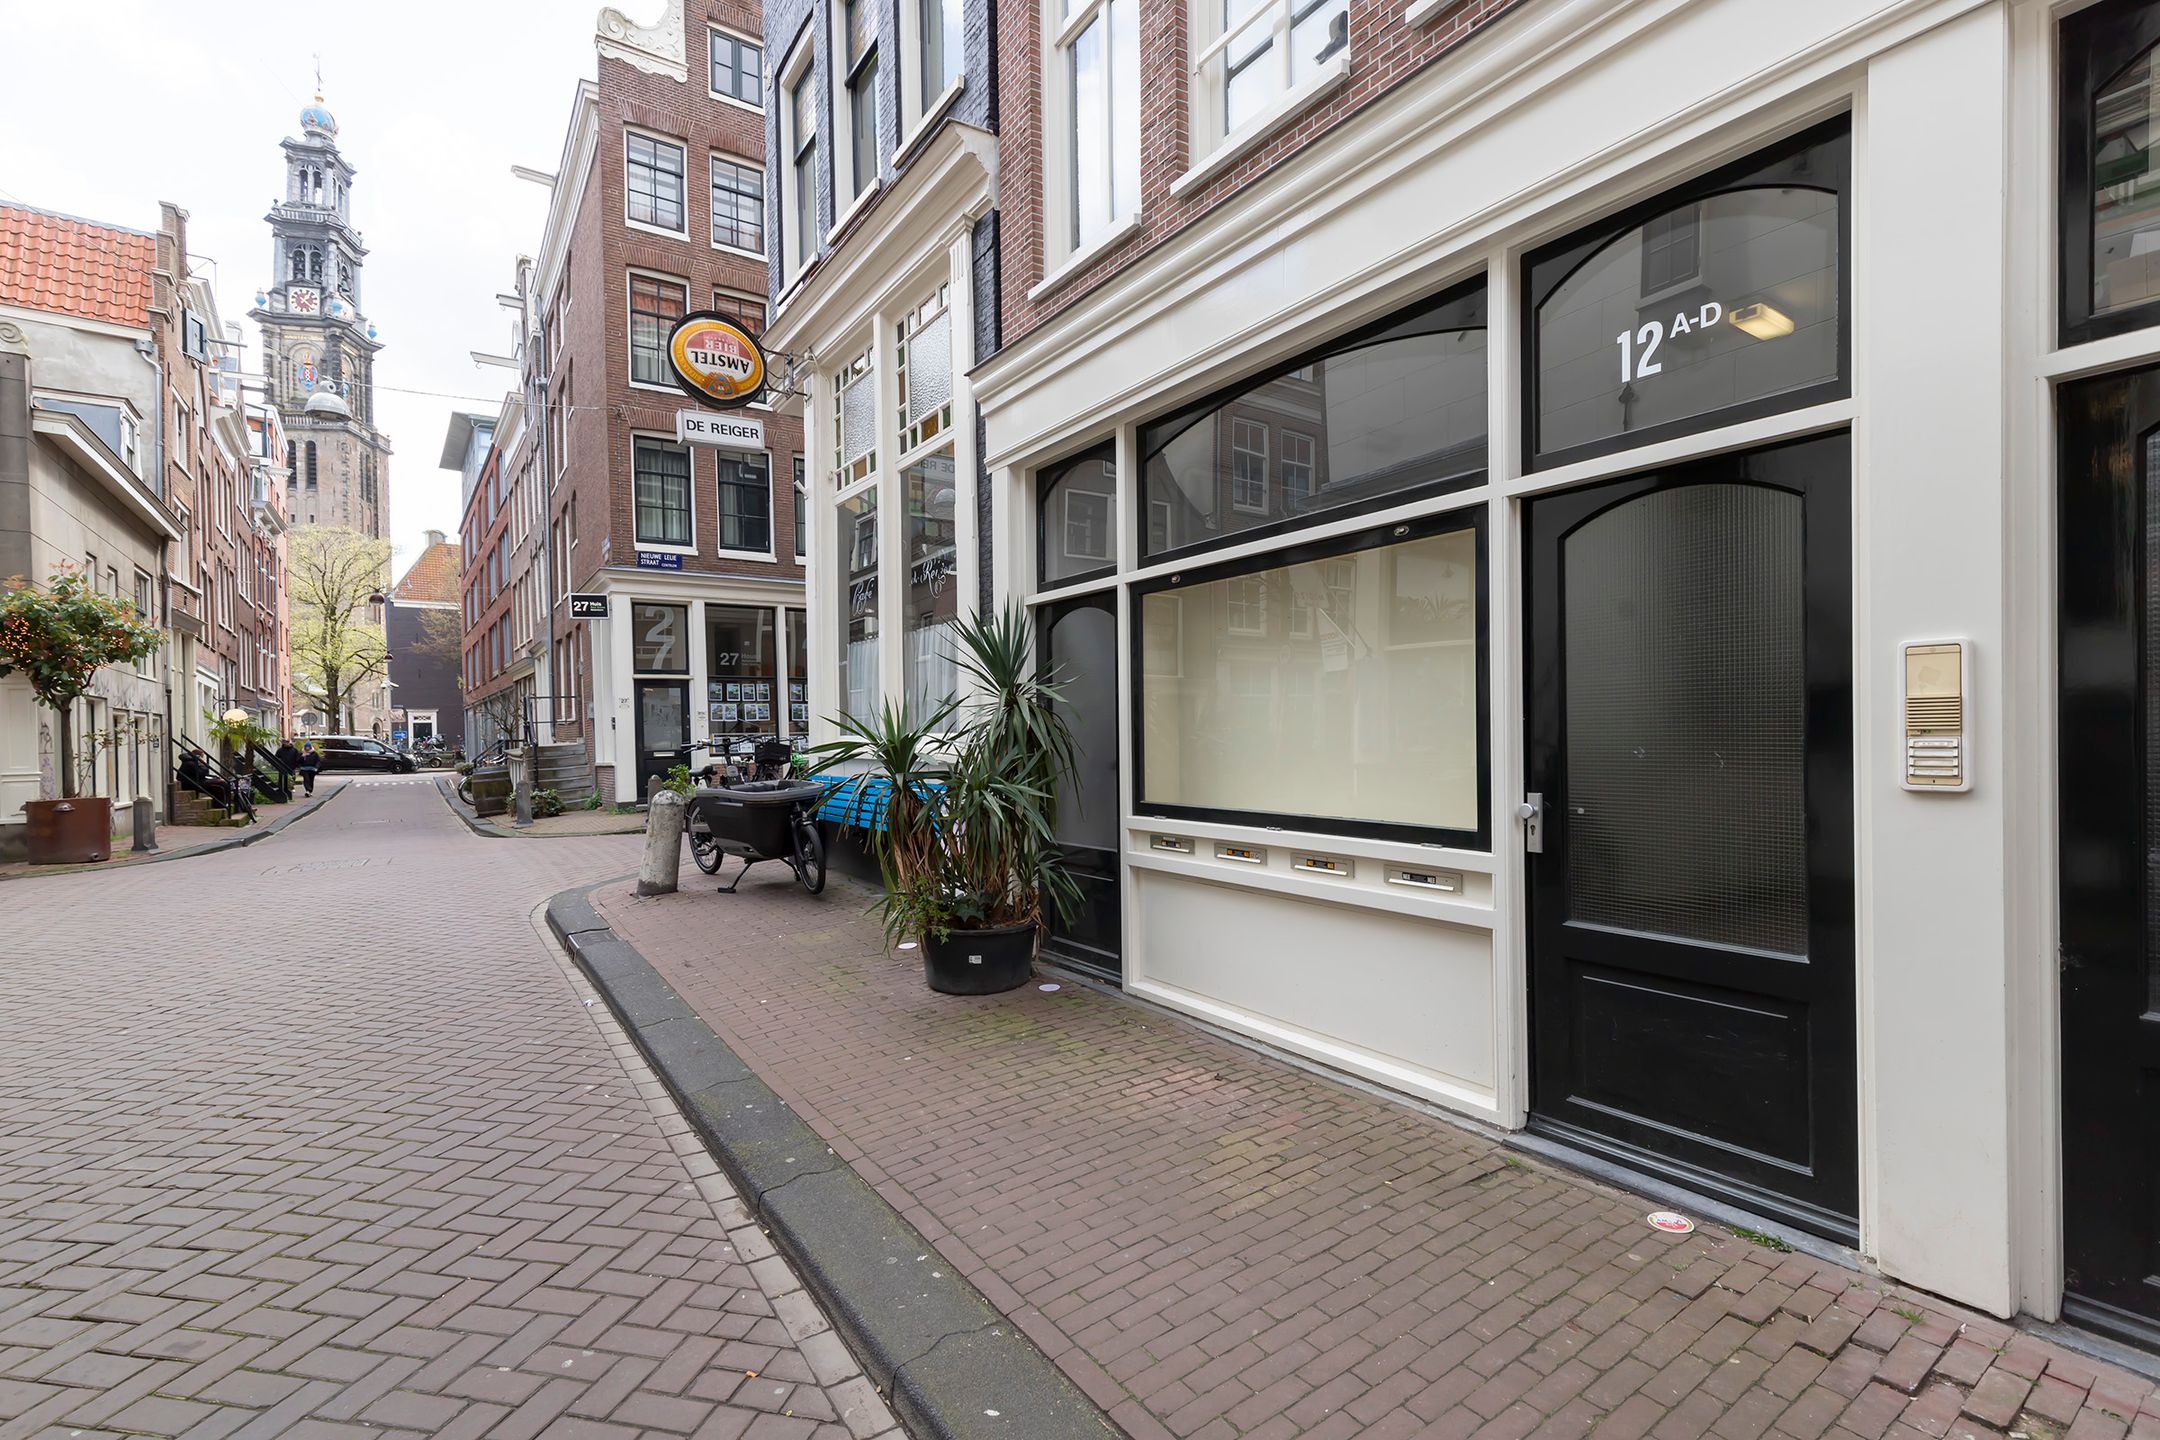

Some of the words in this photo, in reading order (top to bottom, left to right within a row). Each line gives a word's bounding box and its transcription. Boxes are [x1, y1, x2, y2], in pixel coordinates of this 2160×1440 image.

[704, 339, 737, 356] BIER
[1616, 320, 1664, 383] 12
[1669, 301, 1722, 339] A-D
[690, 350, 750, 374] AMSTEL
[686, 419, 705, 432] DE
[710, 422, 760, 439] REIGER
[640, 552, 662, 560] NIEUWE
[573, 601, 589, 611] 27
[719, 652, 740, 666] 27
